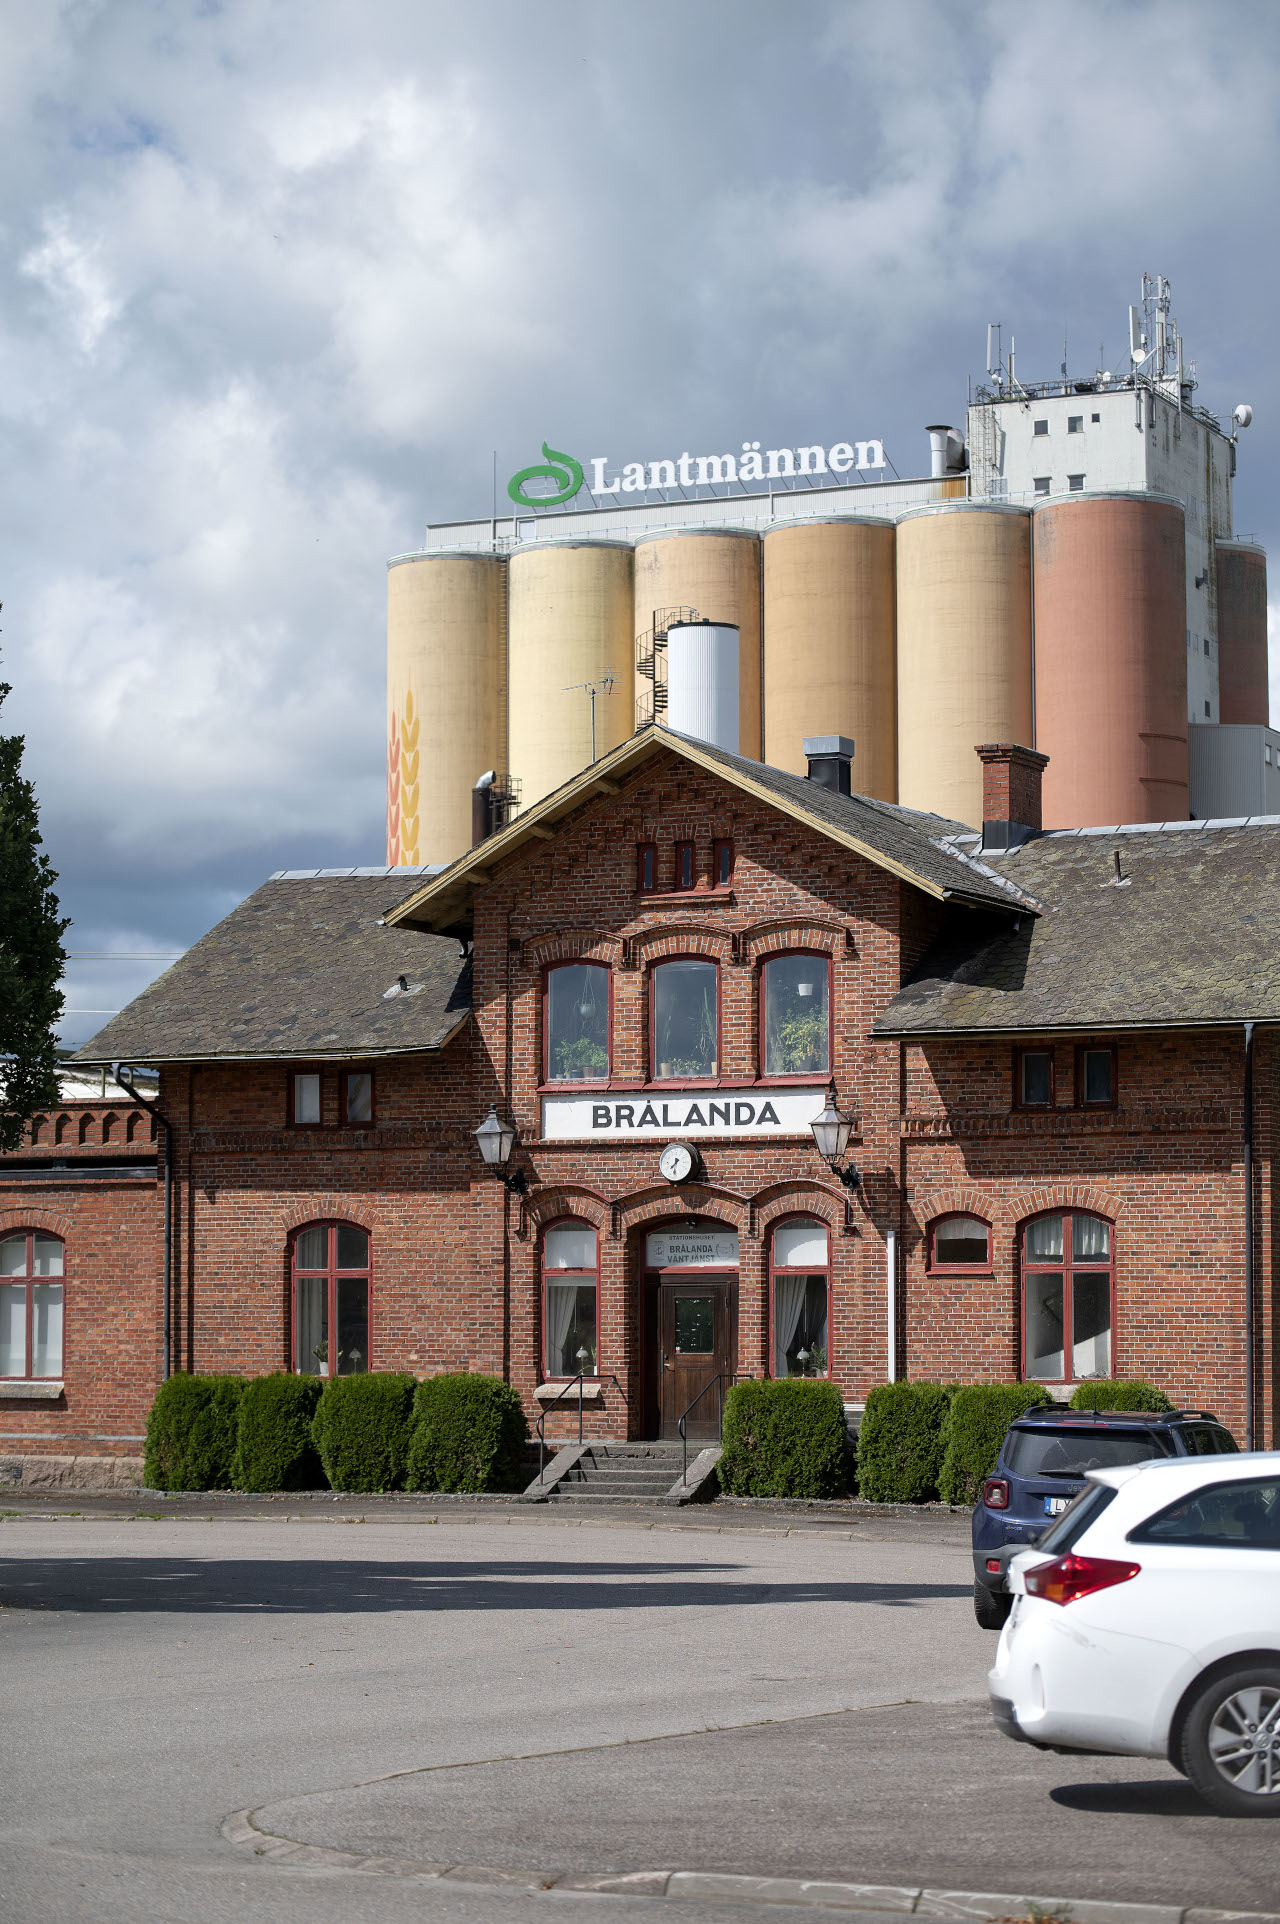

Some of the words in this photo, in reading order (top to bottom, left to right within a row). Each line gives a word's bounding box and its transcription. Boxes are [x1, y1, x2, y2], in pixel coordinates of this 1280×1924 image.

[590, 438, 887, 495] Lantmännen
[592, 1099, 781, 1129] BRÅLANDA
[669, 1244, 714, 1254] BRÅLANDA
